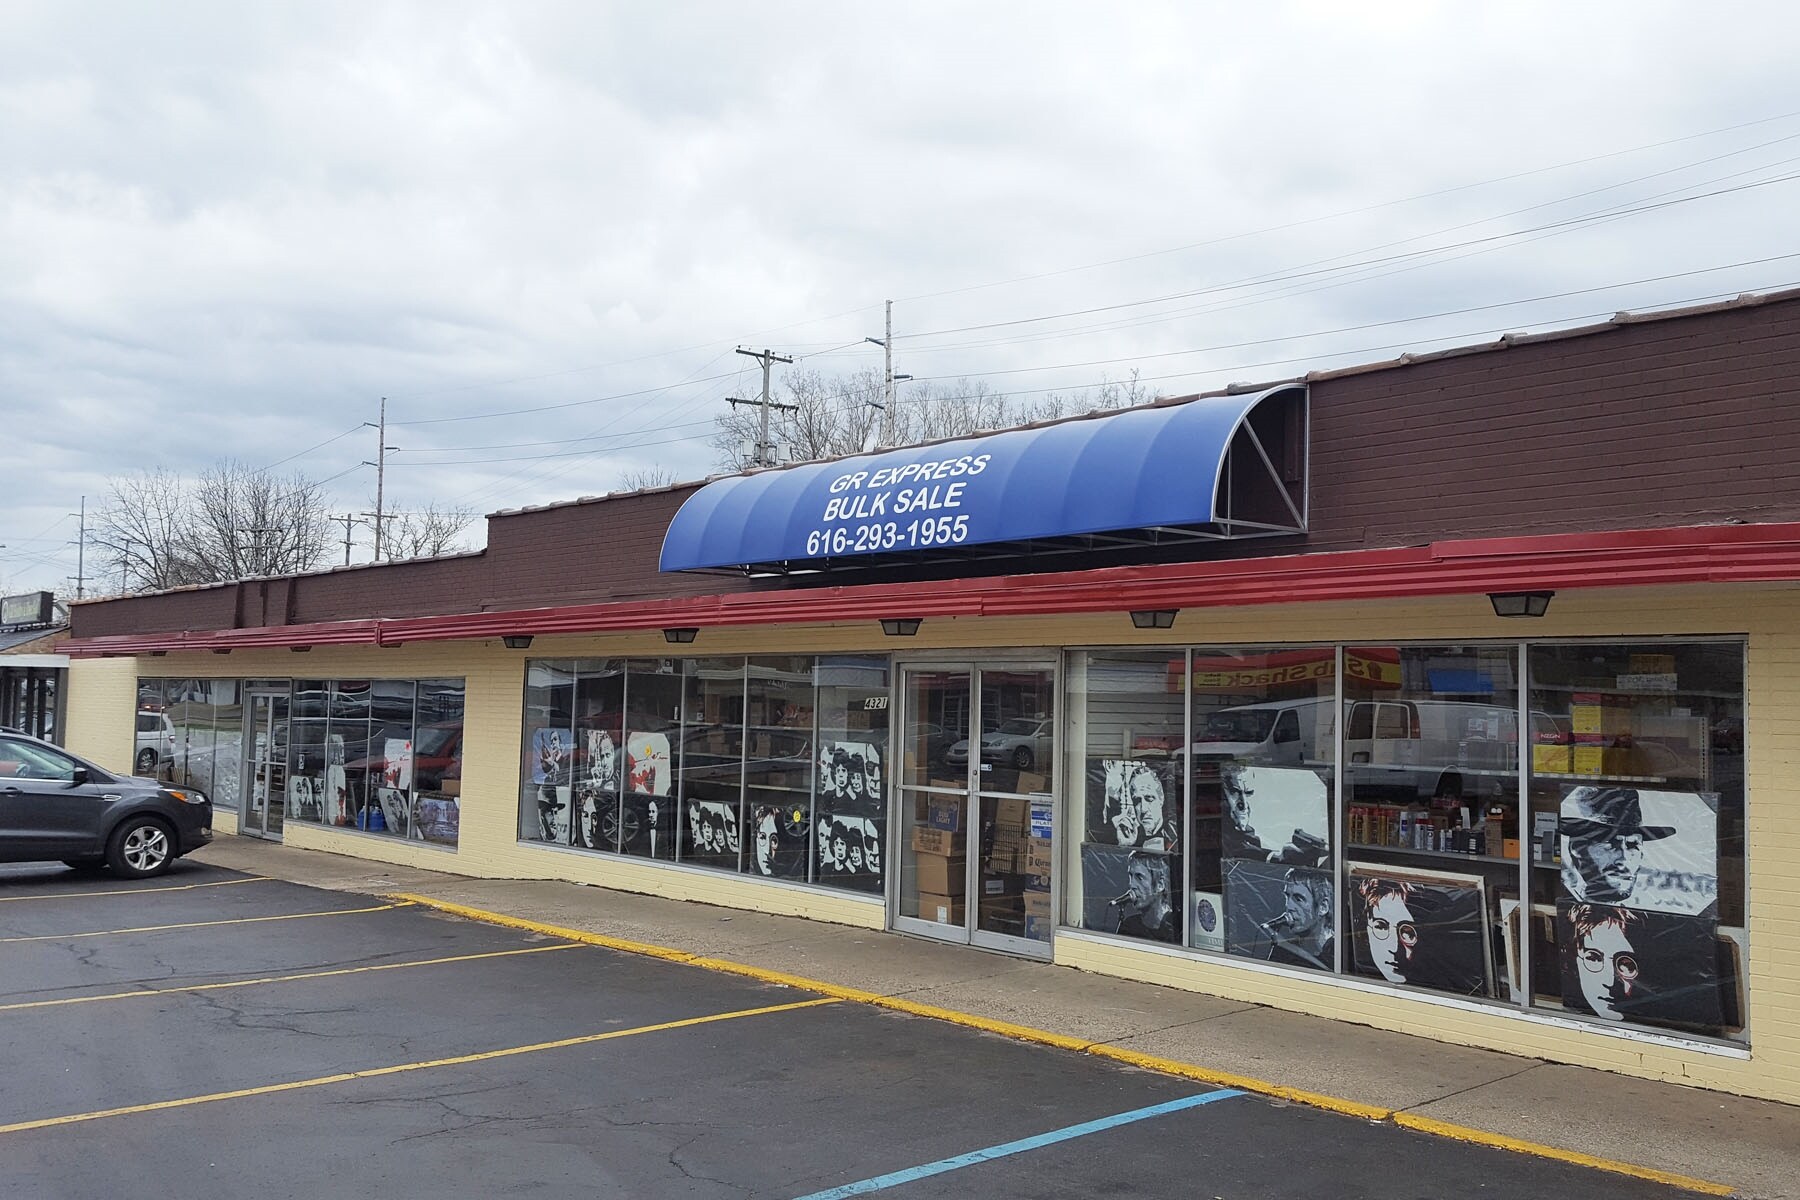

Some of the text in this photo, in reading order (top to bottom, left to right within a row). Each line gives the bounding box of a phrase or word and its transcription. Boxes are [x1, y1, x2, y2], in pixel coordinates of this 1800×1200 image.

[829, 454, 992, 493] GR EXPRESS
[823, 482, 967, 522] BULK SALE
[806, 514, 970, 556] 616-293-1955
[865, 697, 887, 709] 4321
